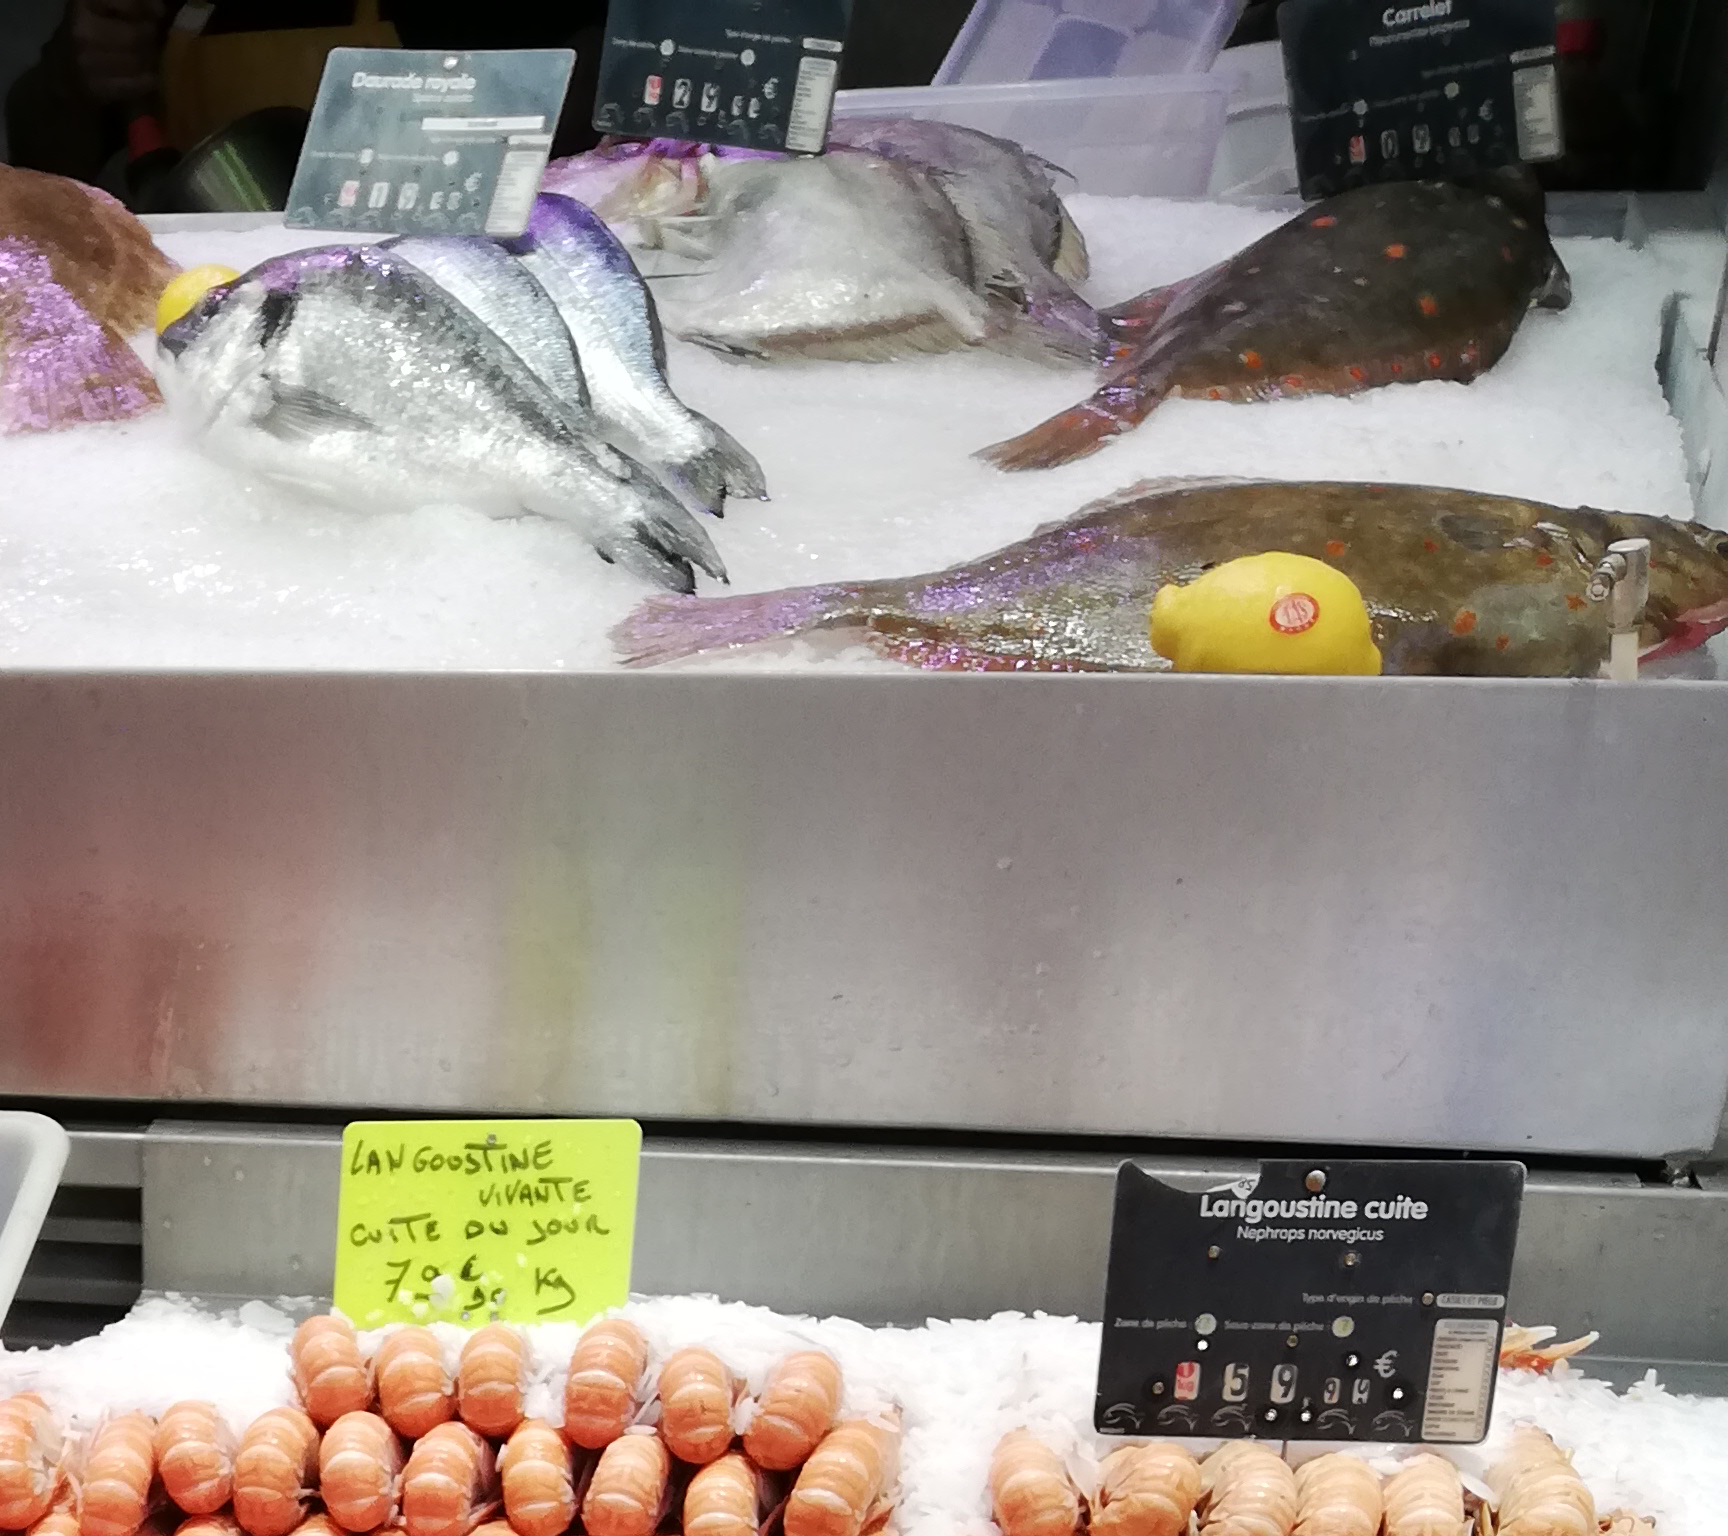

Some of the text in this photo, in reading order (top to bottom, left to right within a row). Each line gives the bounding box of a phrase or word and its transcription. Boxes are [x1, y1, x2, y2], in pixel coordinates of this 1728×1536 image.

[478, 1176, 592, 1207] VIVANTE
[1199, 1194, 1429, 1224] Langoustine cuite
[526, 1213, 609, 1246] JOUR
[1237, 1225, 1384, 1244] Nephrops norvegicus
[1374, 1350, 1399, 1378] €
